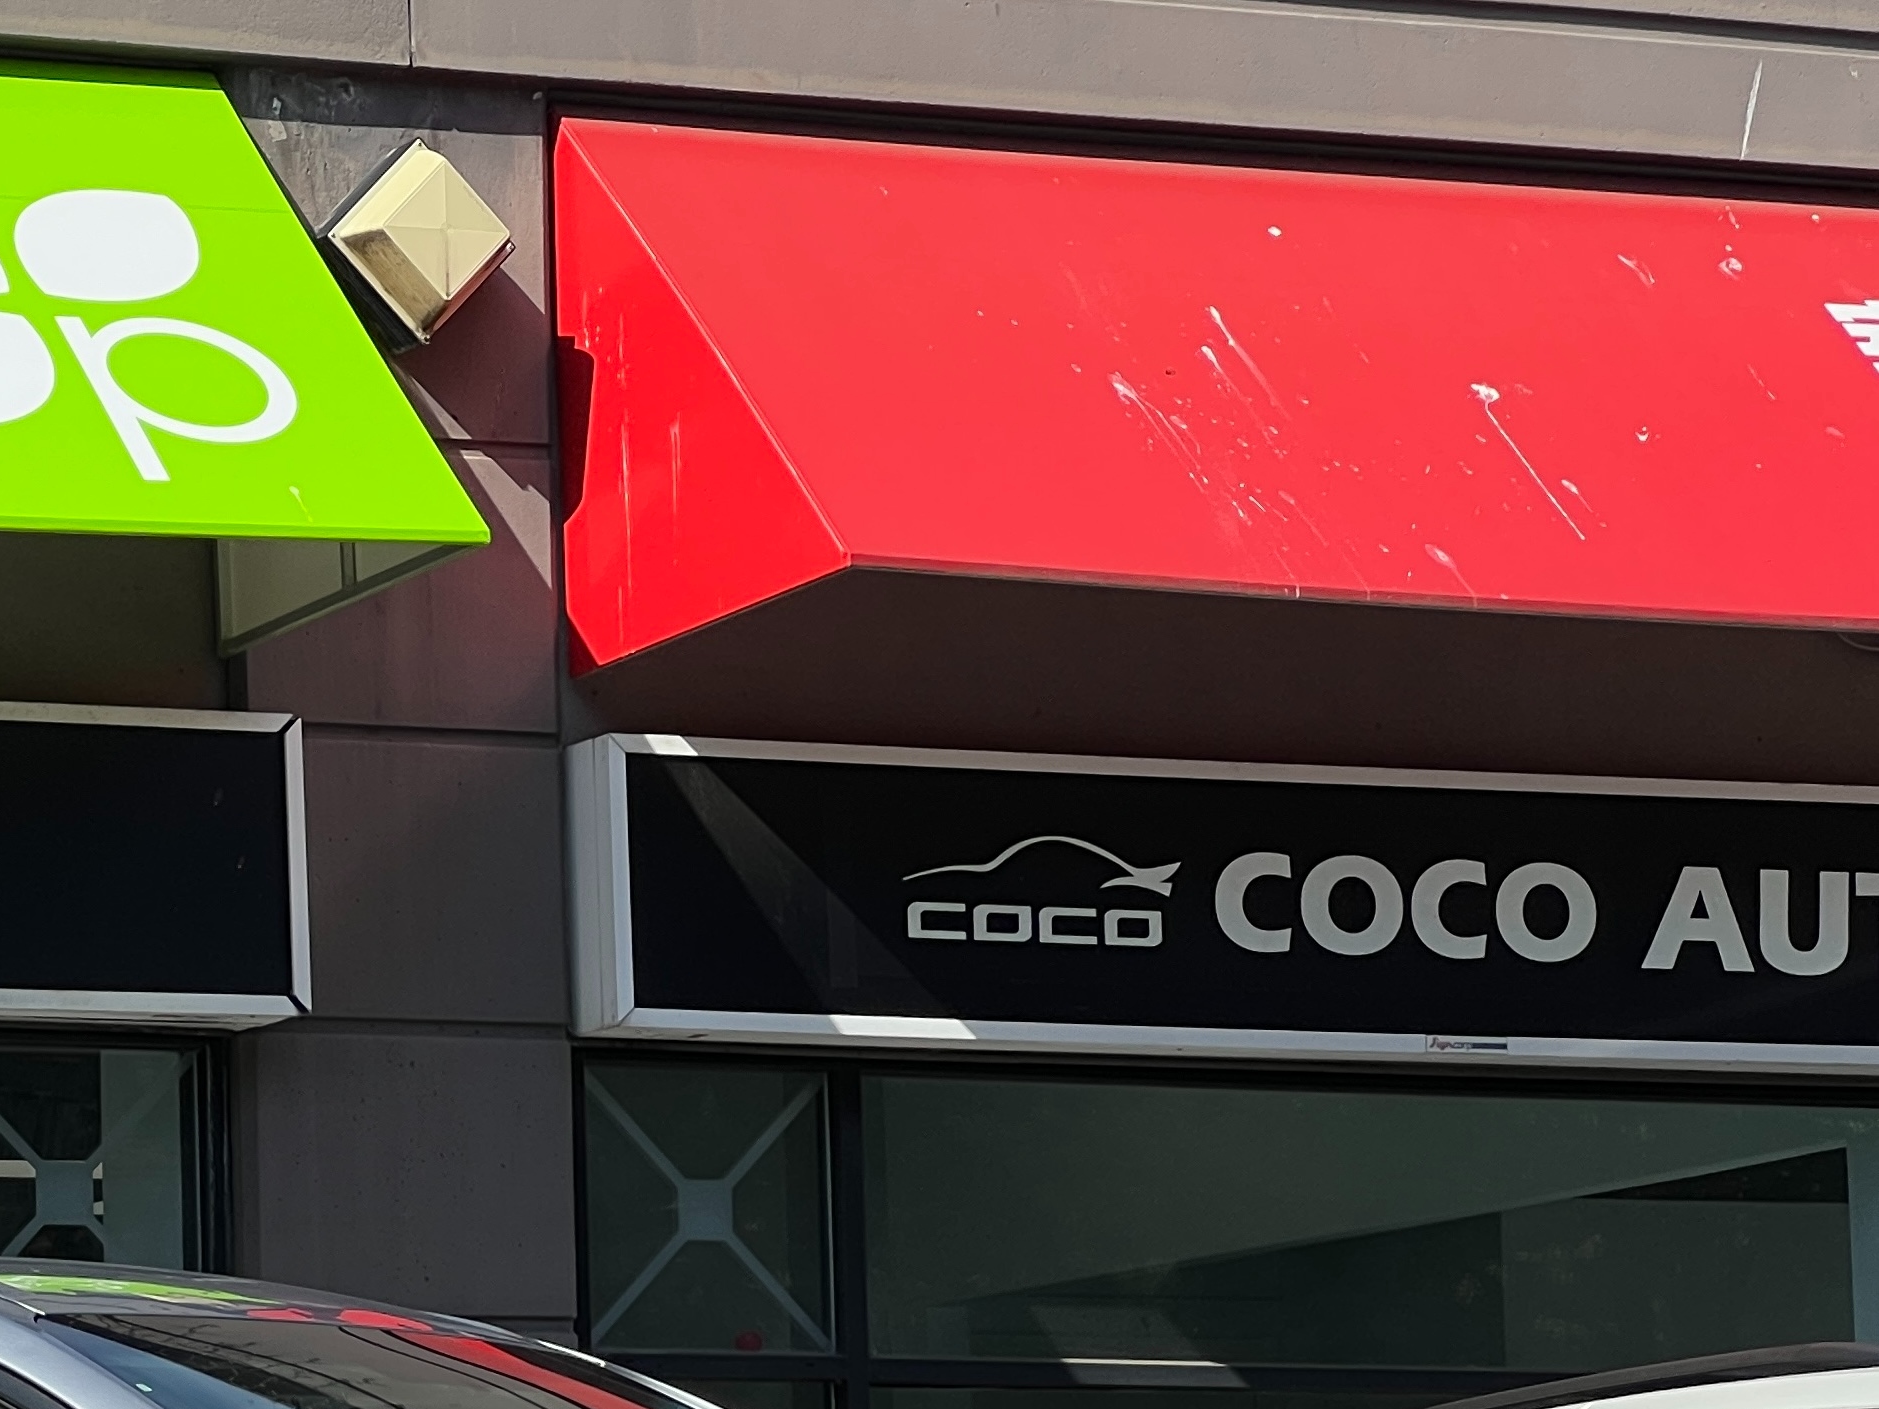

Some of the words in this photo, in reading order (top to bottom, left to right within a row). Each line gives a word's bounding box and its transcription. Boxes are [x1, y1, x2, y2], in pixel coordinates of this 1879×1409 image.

[907, 901, 1163, 947] COCO
[1214, 851, 1597, 963] COCO
[1640, 865, 1879, 976] AU
